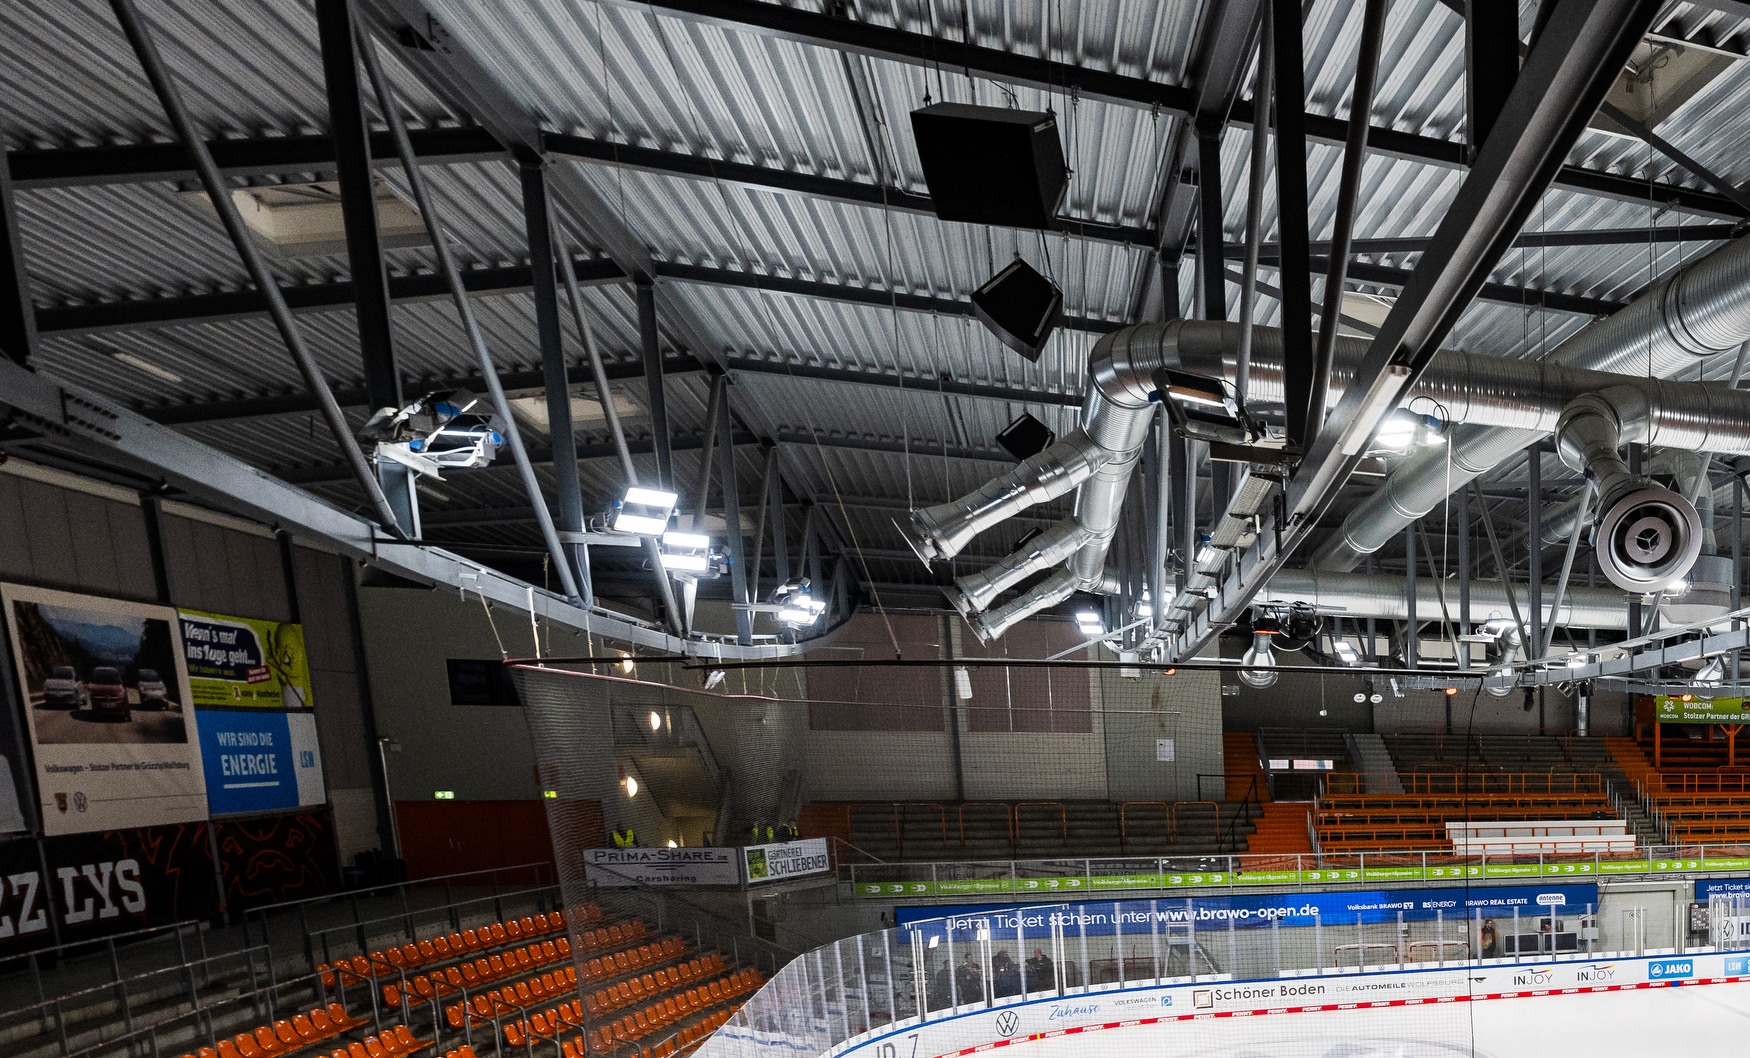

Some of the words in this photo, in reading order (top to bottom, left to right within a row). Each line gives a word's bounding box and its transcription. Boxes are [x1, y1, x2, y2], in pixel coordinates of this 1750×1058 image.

[1683, 702, 1714, 710] WOBCOM:
[216, 731, 237, 747] WIR
[237, 732, 259, 747] SIND
[259, 732, 273, 747] DIE
[220, 753, 278, 777] ENERGIE
[768, 855, 829, 877] SCHLIEBENER
[1706, 883, 1723, 892] Jetzt
[1724, 883, 1743, 891] Ticket
[1347, 903, 1378, 911] Volksbank
[1378, 902, 1403, 910] BRAWO
[1490, 898, 1507, 906] REAL
[995, 914, 1044, 928] Ticket
[1049, 911, 1107, 926] sichern
[1111, 911, 1152, 924] unter
[1157, 904, 1320, 922] www.brawo-open.de
[1664, 963, 1691, 974] JAKO
[1728, 961, 1742, 971] LSW
[1513, 973, 1553, 986] INJOY
[1577, 969, 1616, 982] INJOY
[1215, 986, 1277, 1001] Schöner
[1280, 984, 1326, 997] Boden
[1351, 982, 1406, 991] AUTOMEILE
[1113, 996, 1157, 1007] VOLKSWAGEN
[1048, 1005, 1101, 1022] Zuhause
